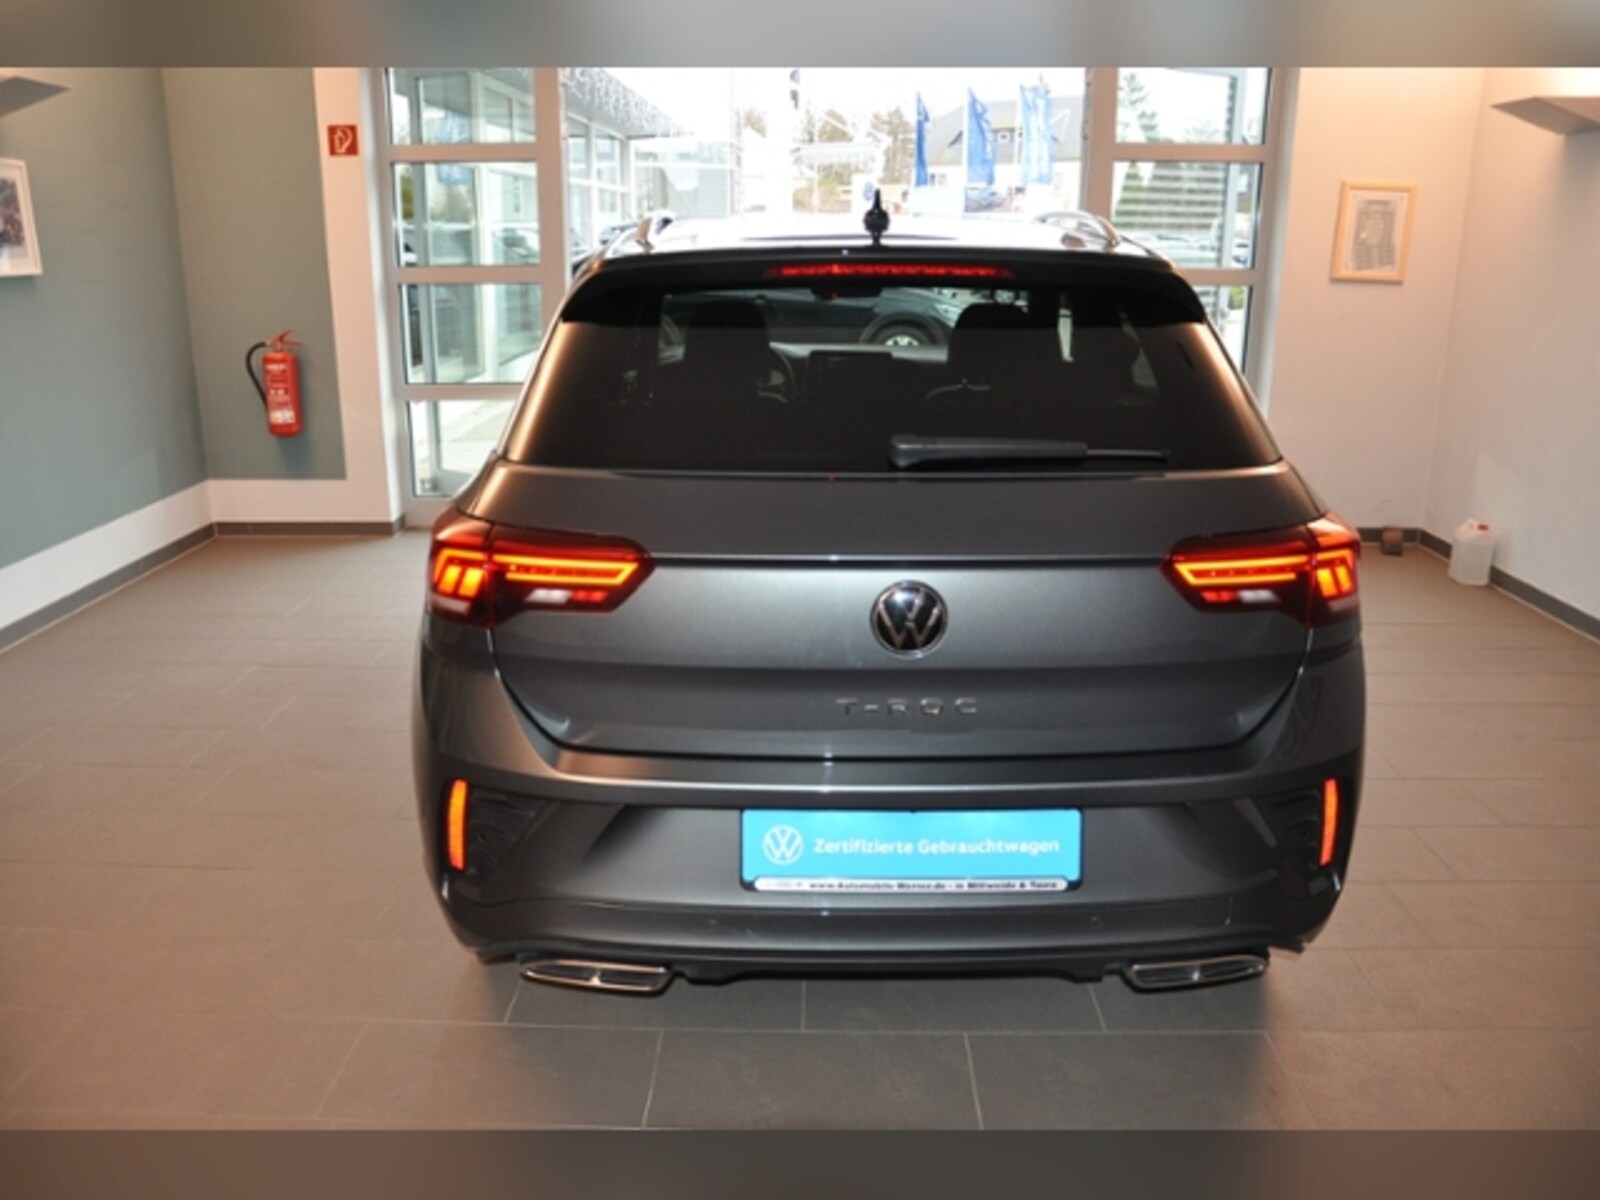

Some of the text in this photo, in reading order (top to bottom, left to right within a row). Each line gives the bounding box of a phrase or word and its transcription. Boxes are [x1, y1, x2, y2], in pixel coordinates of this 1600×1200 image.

[835, 697, 977, 715] T-ROC
[814, 837, 1061, 856] Zertifizierte Gebrauchtwagen
